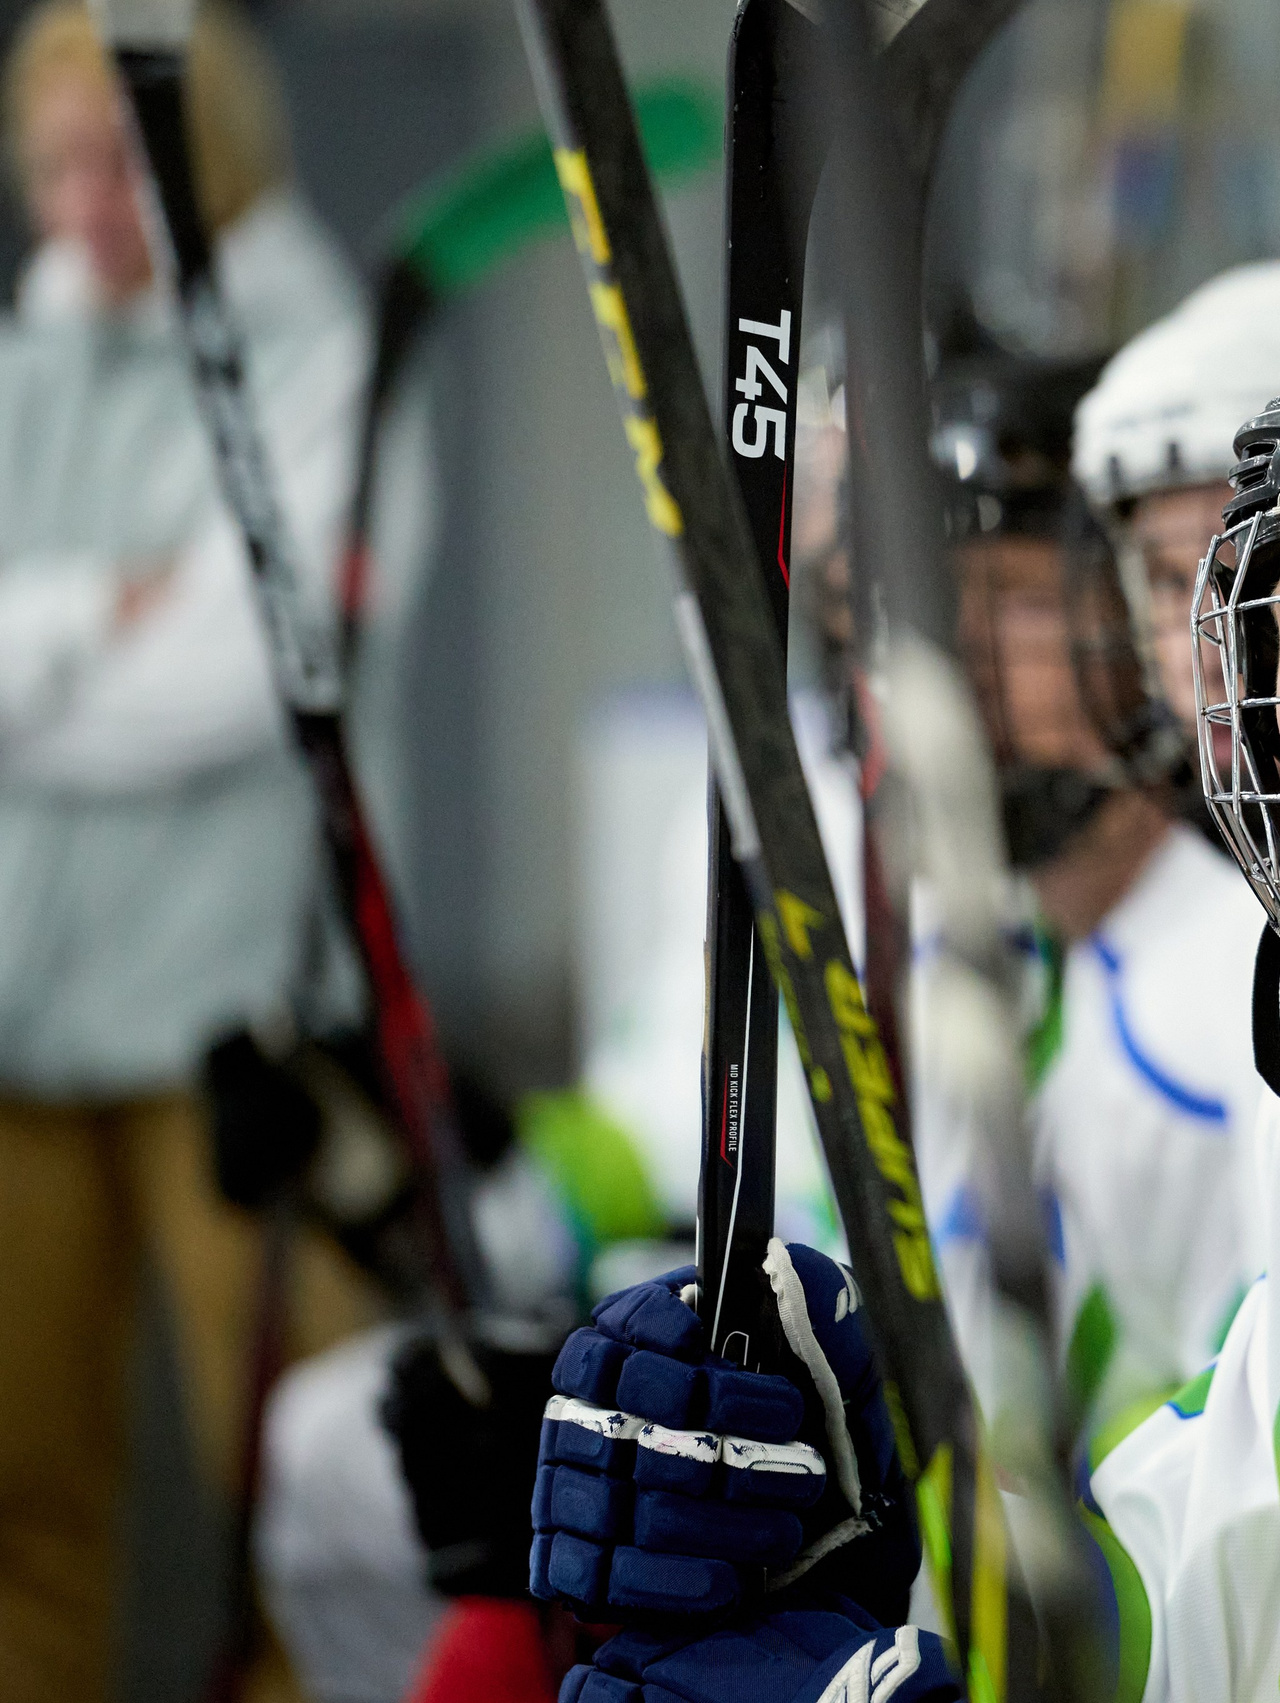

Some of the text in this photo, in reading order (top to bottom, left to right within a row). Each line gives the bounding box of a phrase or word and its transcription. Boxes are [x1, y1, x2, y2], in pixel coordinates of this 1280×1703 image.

[732, 309, 792, 461] T45
[728, 1064, 739, 1152] MID KICK FLEX PROFILE
